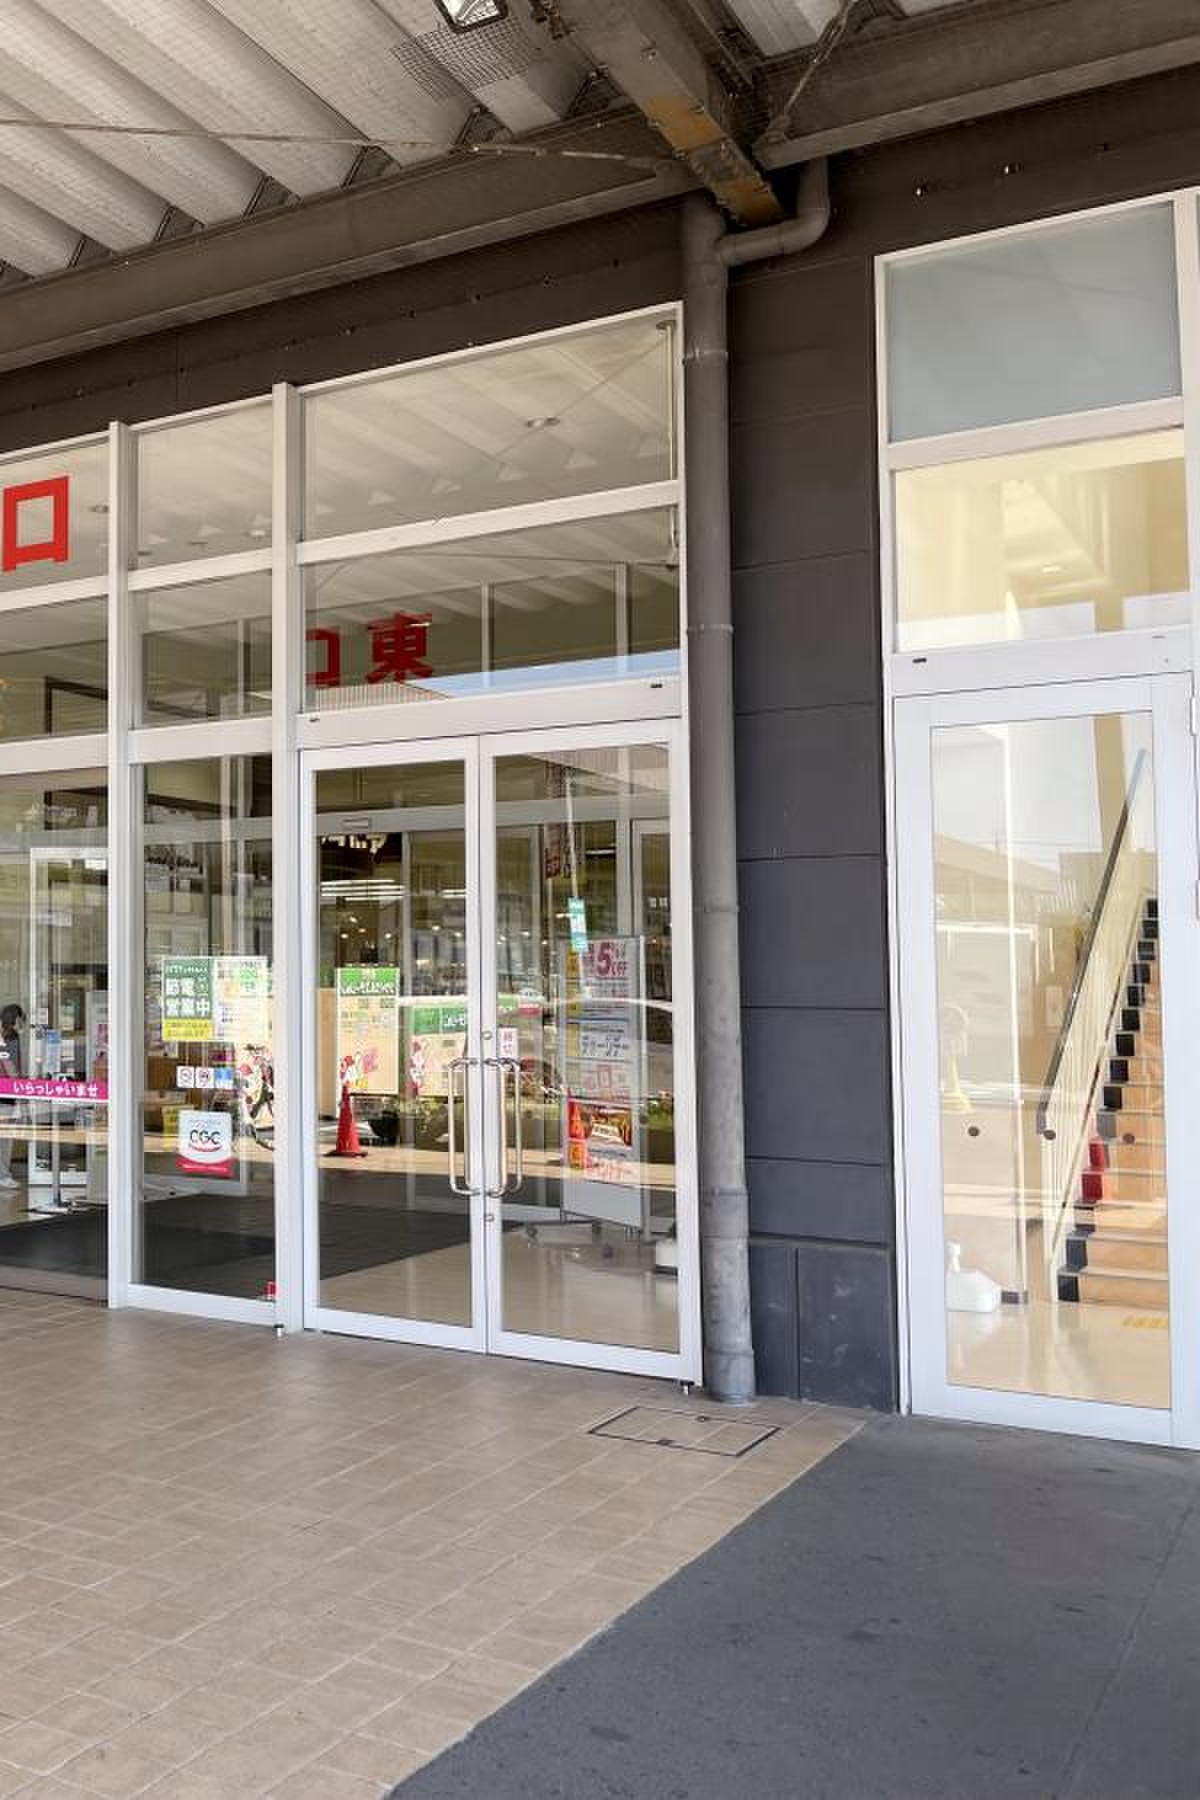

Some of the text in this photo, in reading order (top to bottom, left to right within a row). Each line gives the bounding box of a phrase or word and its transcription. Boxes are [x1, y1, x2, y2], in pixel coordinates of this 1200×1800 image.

[13, 1081, 99, 1097] いらっしゃいませ
[189, 1129, 222, 1146] CGC
